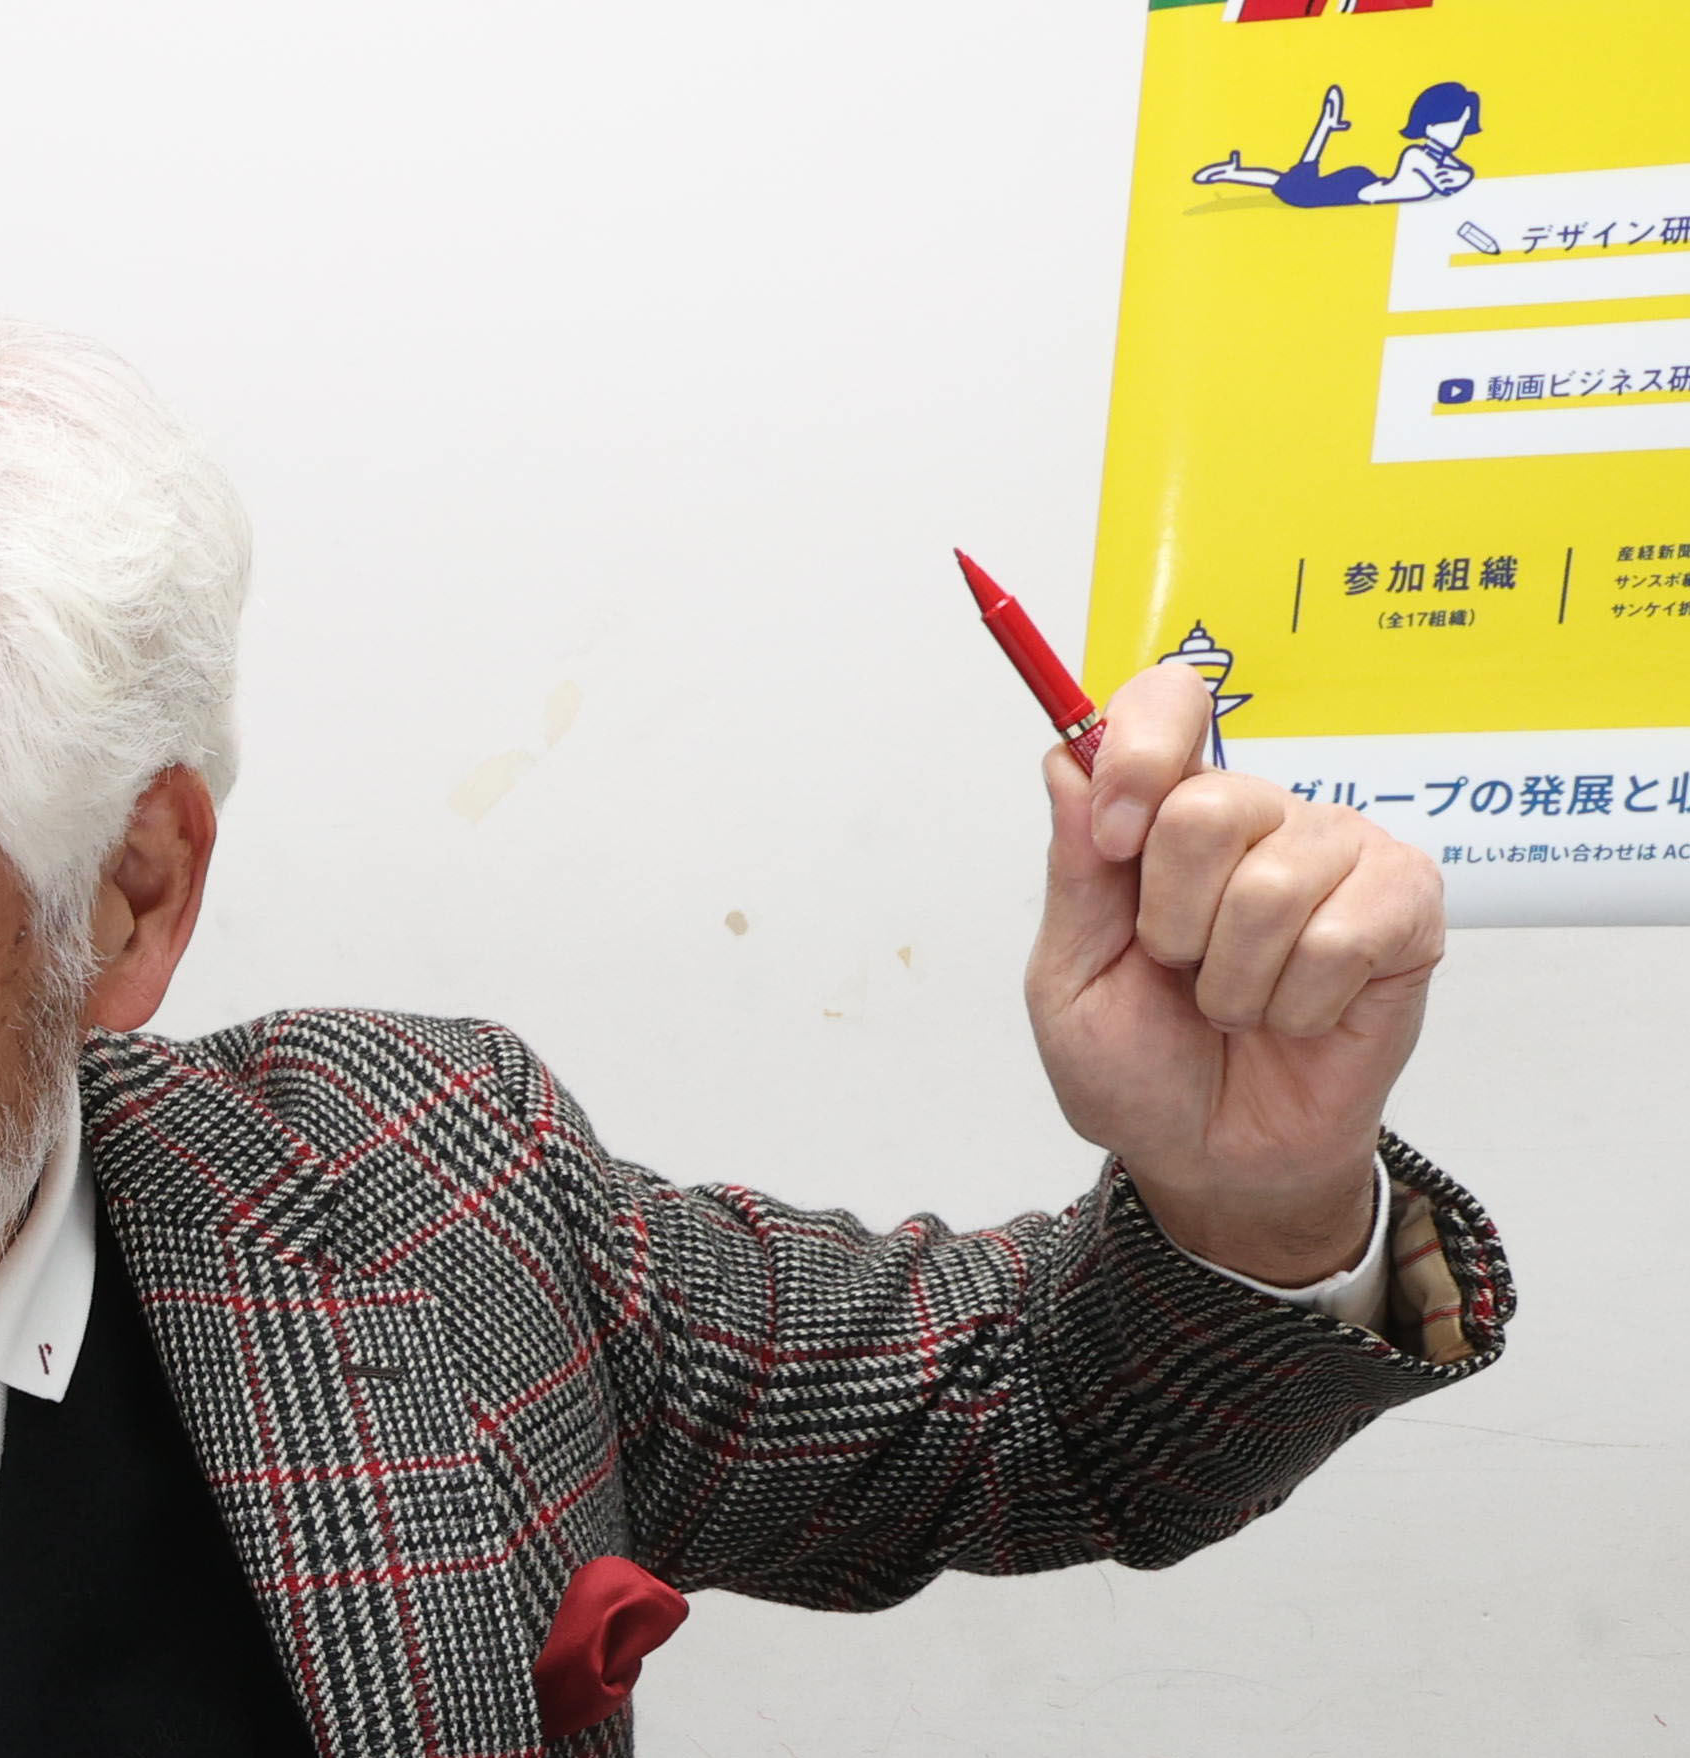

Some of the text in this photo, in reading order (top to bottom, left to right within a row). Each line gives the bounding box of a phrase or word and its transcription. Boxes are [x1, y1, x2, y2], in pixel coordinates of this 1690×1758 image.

[1520, 216, 1690, 255] デザイン研
[1486, 366, 1690, 402] 動画ビジネス研
[1344, 557, 1520, 596] 参加組織
[1377, 609, 1477, 629] (全17組織)
[1443, 843, 1657, 864] 詳しいお問い合わせは
